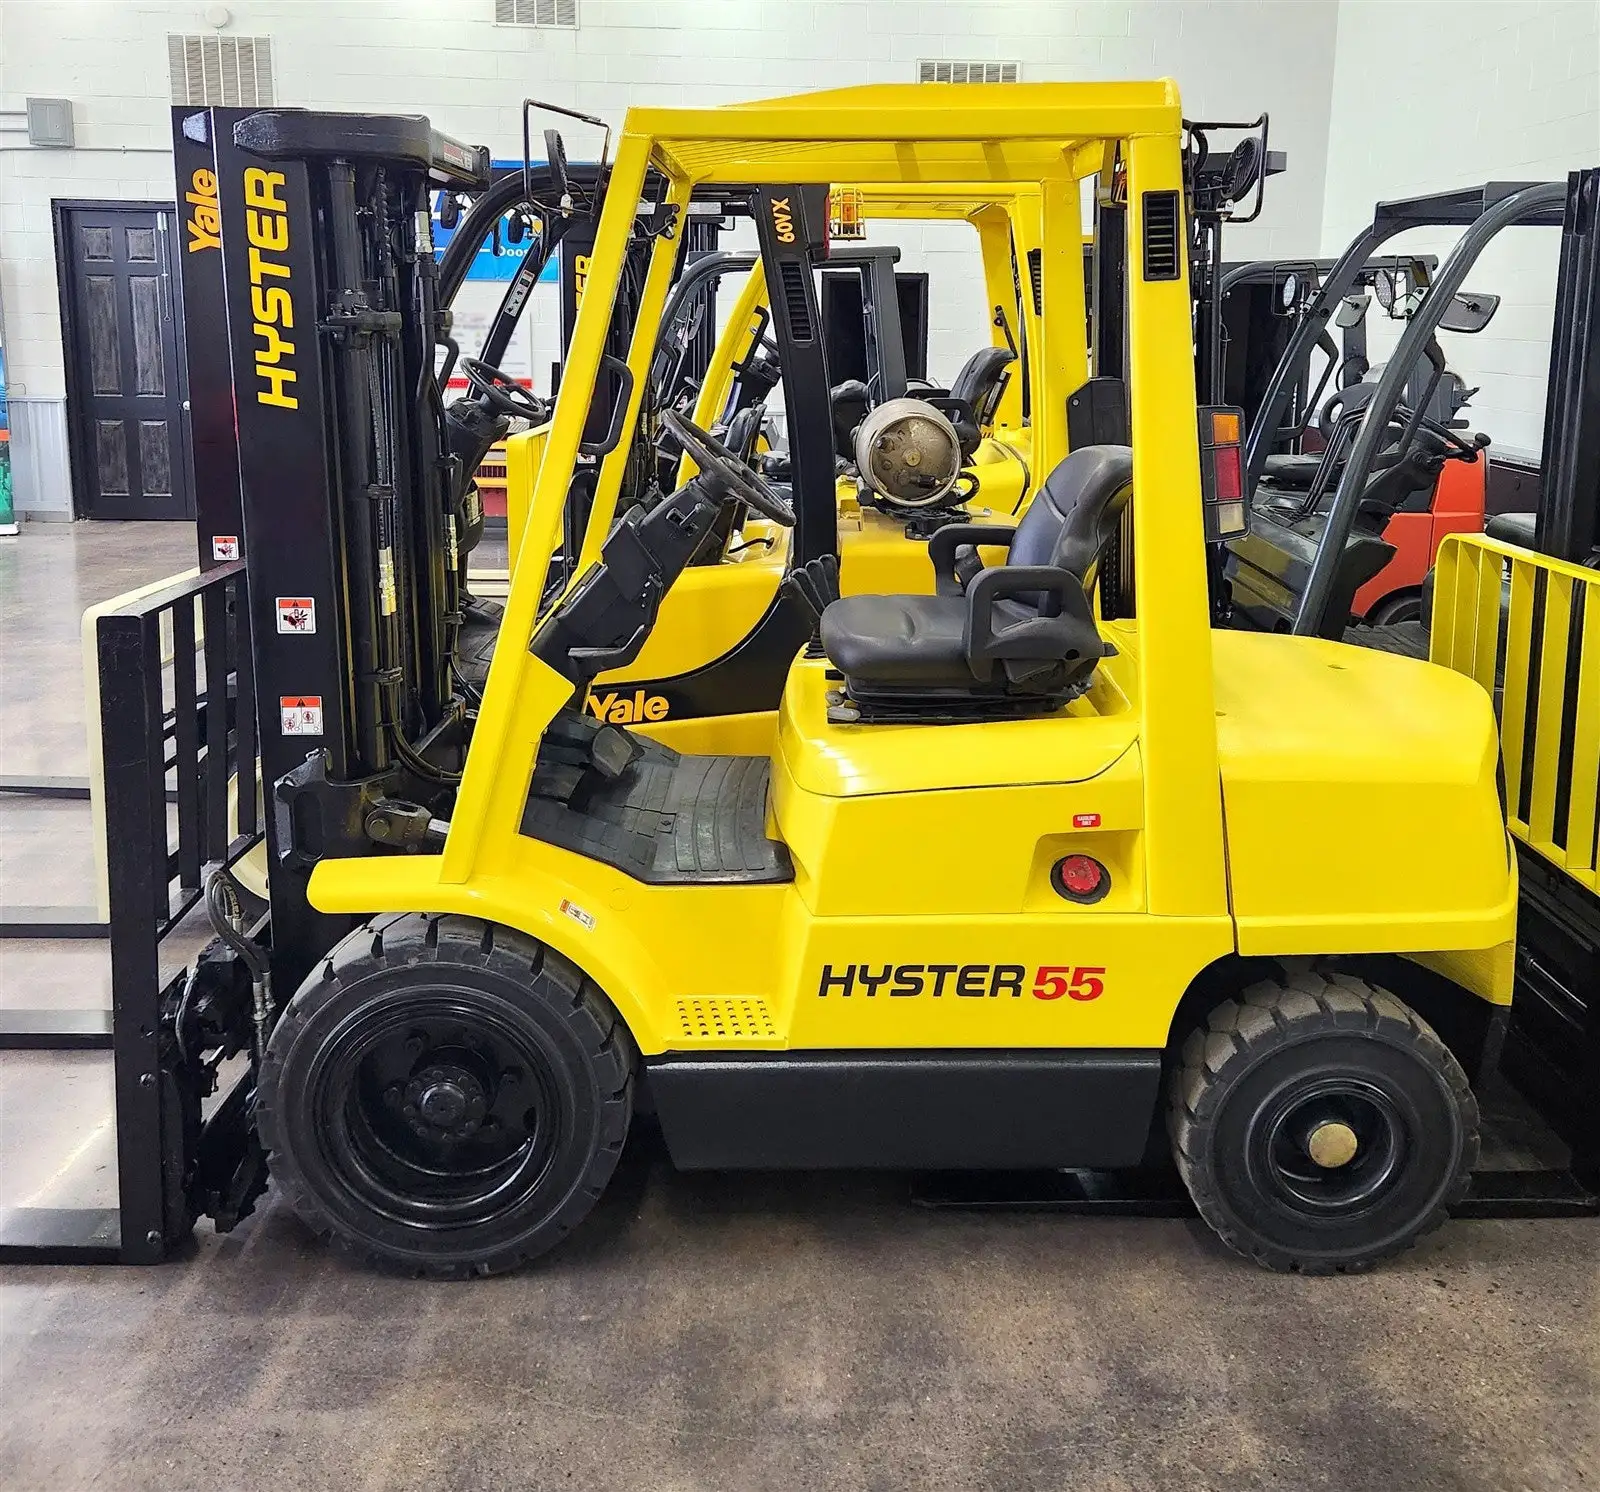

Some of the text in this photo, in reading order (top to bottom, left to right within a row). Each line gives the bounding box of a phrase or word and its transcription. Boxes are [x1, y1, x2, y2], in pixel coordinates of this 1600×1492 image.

[185, 167, 222, 253] Yale
[770, 197, 796, 244] 60VX
[243, 166, 299, 410] HYSTER
[588, 689, 670, 724] Yale
[817, 964, 1106, 1002] HYSTER 55
